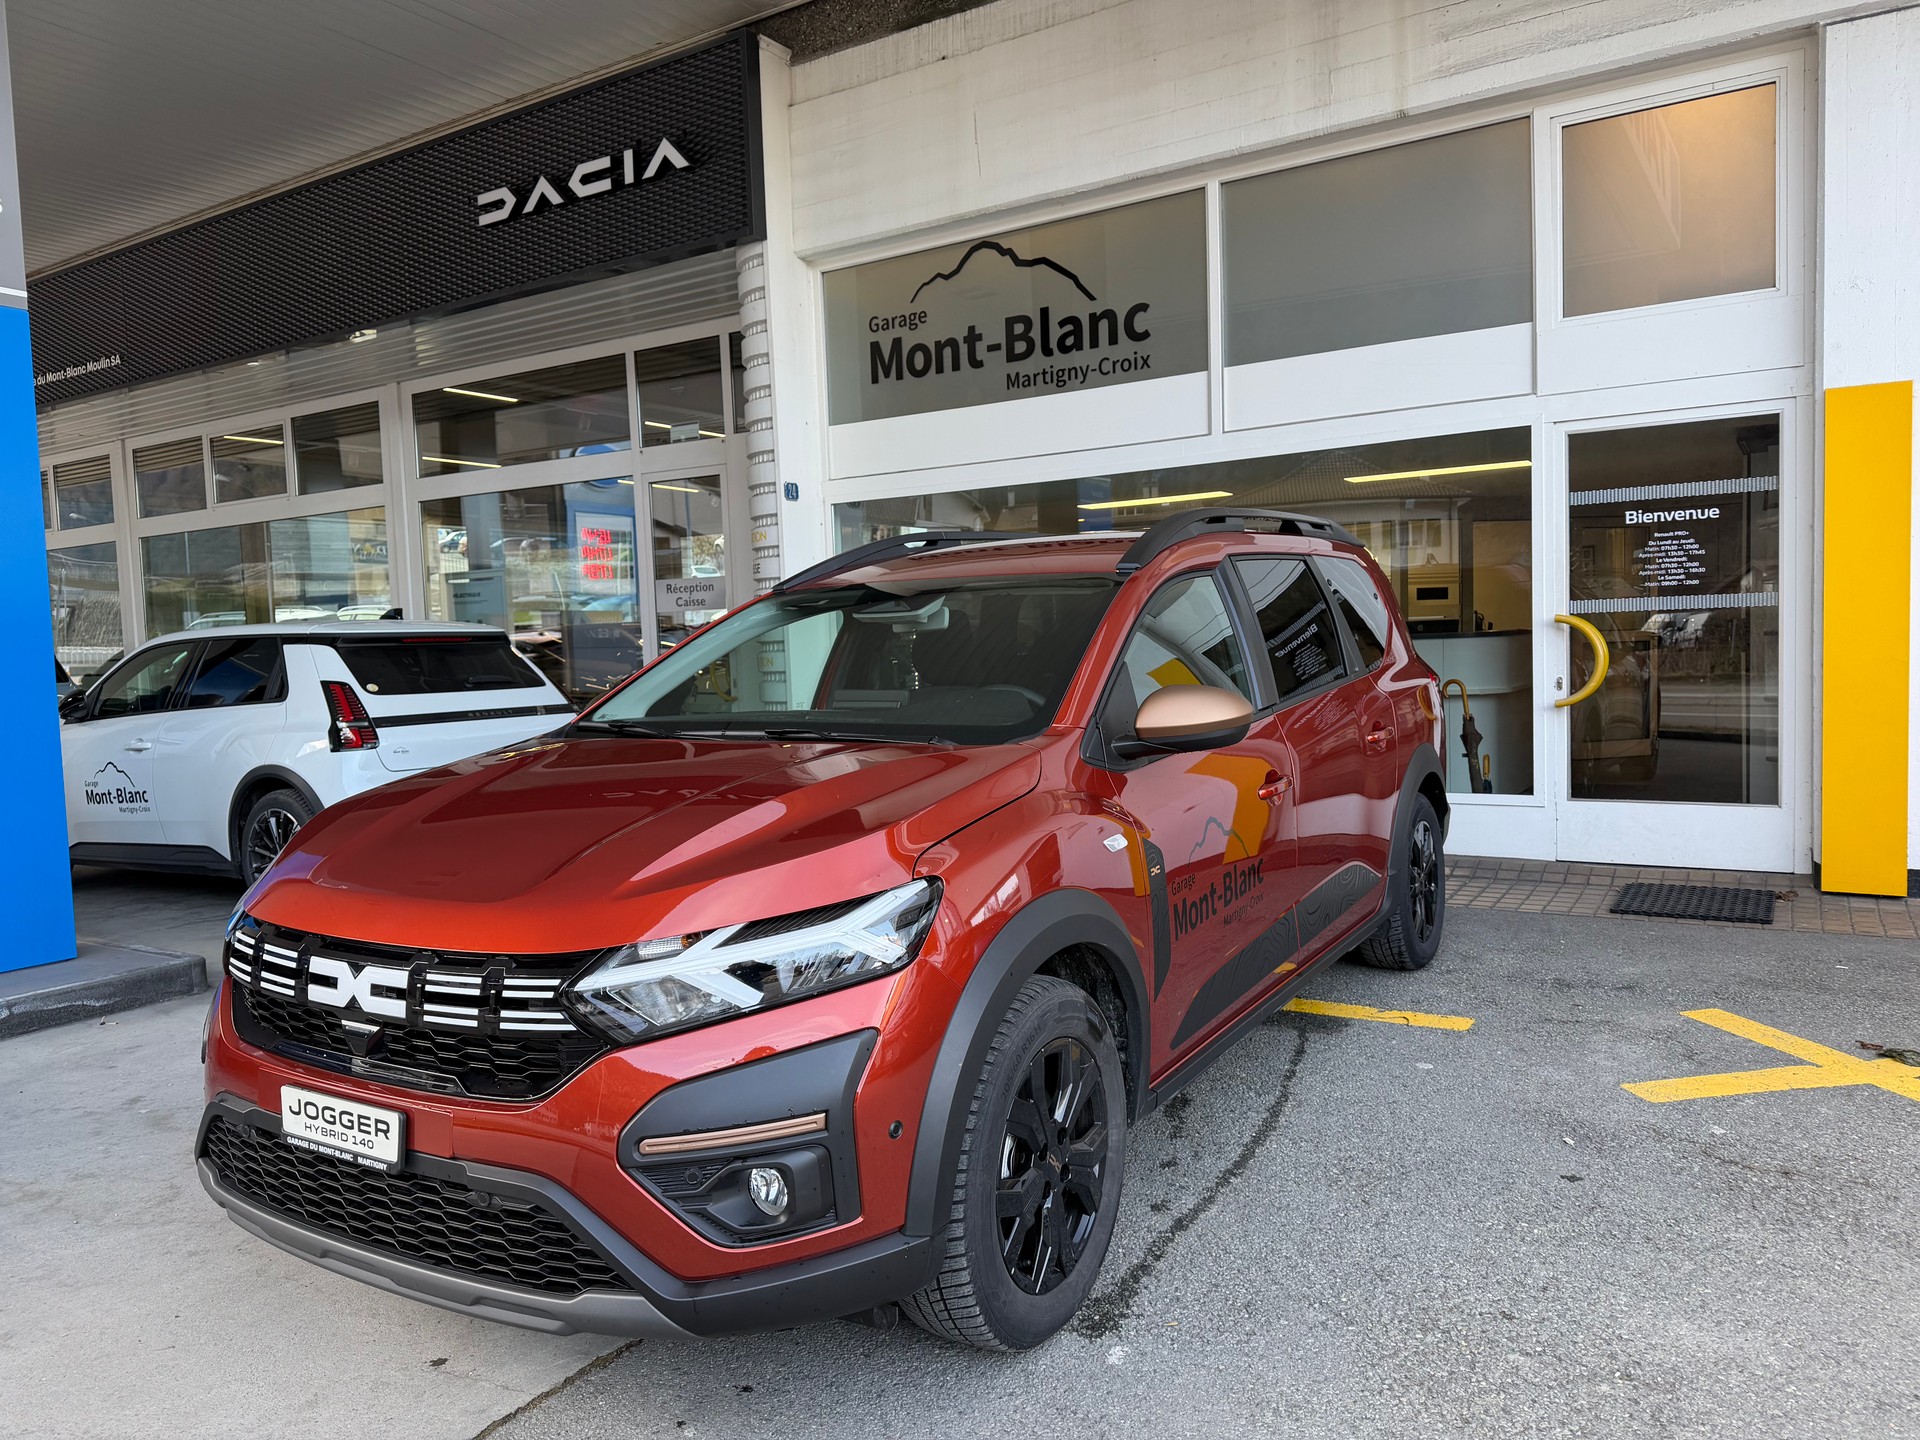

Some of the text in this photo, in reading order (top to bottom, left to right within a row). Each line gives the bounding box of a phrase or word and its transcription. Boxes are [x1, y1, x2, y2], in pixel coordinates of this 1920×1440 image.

[477, 137, 690, 227] DACIA
[868, 310, 928, 333] Garage
[869, 302, 1151, 384] Mont-Blanc
[37, 374, 46, 385] du
[46, 365, 86, 383] Mont-Blanc
[86, 357, 111, 373] Moulin
[110, 354, 121, 366] SA
[1006, 351, 1151, 391] Martigny-Croix
[788, 484, 797, 499] 24
[1625, 507, 1720, 525] Bienvenue
[666, 582, 714, 596] Réception
[675, 596, 706, 607] Caisse
[84, 780, 99, 788] Garage
[85, 787, 149, 805] Mont-Blanc
[118, 804, 151, 814] Martigny-Croix
[1171, 873, 1196, 896] Garage
[1173, 857, 1264, 942] Mont-Blanc
[1223, 891, 1264, 928] Martigny-Croix
[288, 1098, 391, 1140] JOGGER
[304, 1122, 375, 1150] HYBRID 140
[286, 1136, 388, 1171] GARAGE DU MONT-BLANC MARTIGNY
